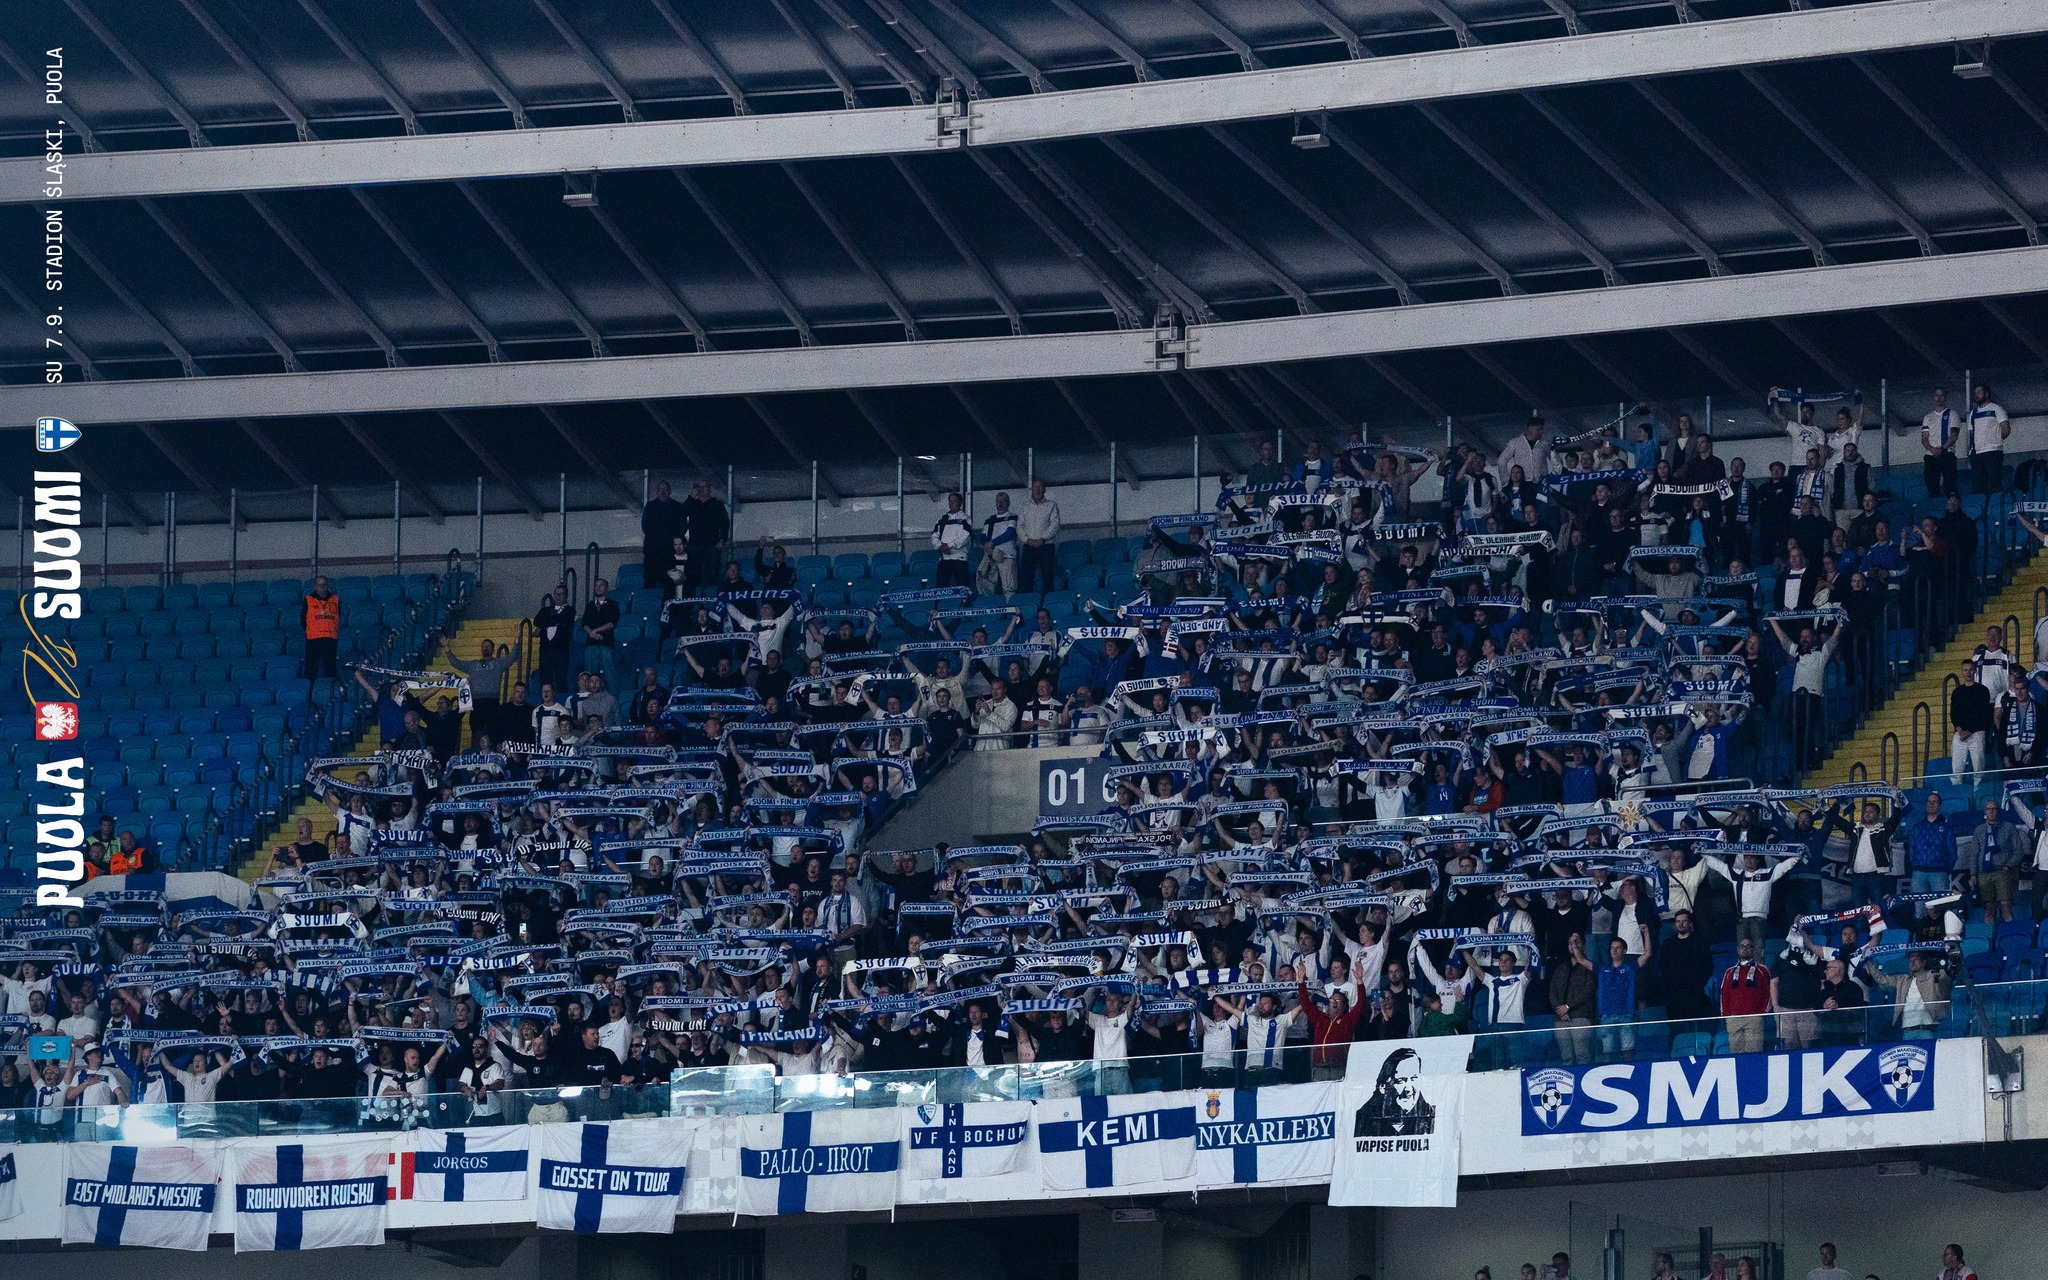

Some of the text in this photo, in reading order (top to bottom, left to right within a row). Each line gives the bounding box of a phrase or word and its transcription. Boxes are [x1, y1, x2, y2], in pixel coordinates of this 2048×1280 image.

[1559, 470, 1625, 483] SUOMI
[1233, 482, 1298, 495] SUOMI
[1280, 494, 1327, 505] SUOMI
[1179, 515, 1209, 523] FINLAND
[1220, 523, 1271, 537] SUOMI
[1375, 528, 1425, 540] SUOMI
[1250, 546, 1288, 555] FINLAND
[728, 589, 792, 599] SUOMI
[889, 589, 953, 601] SUOMI FINLAND
[1080, 627, 1127, 638] SUOMI
[1521, 651, 1555, 659] FINLAND
[1329, 668, 1402, 676] POHJOISKAARRE
[1128, 679, 1154, 690] SUOMI
[1686, 680, 1737, 691] SUOMI
[1624, 705, 1673, 718] SUOMI
[1157, 729, 1205, 742] SUOMI
[771, 765, 813, 774] SUOMI
[1048, 767, 1085, 807] 01
[1519, 804, 1555, 812] FINLAND
[1040, 815, 1111, 823] POHJOISKAARRE
[380, 830, 424, 841] SUOMI
[1231, 873, 1305, 881] POHJOISKAARRE
[1510, 878, 1593, 889] POHJOISKAARRE
[295, 889, 375, 899] POHJOISKAARRE
[803, 889, 823, 897] new
[1288, 882, 1358, 899] SUOMI FINLAND
[295, 914, 338, 926] SUOMI
[1140, 932, 1185, 945] SUOMI
[1418, 928, 1473, 939] SUOMI
[1044, 938, 1124, 951] POHJOISKAARRE
[1871, 944, 1900, 953] SUOMI
[855, 957, 908, 969] SUOMI
[1580, 1048, 1873, 1128] SMJK
[1076, 1113, 1160, 1147] KEMI
[1198, 1114, 1334, 1148] NYKARLEBY
[1355, 1137, 1430, 1153] VAPISE PUOLA
[432, 1155, 488, 1170] JORGOS
[552, 1165, 670, 1193] GOSSET ON TOUR
[73, 1182, 202, 1208] EAST MIDLANDS MASSIVE
[245, 1182, 374, 1210] ROIHUVUOREN RUISKU
